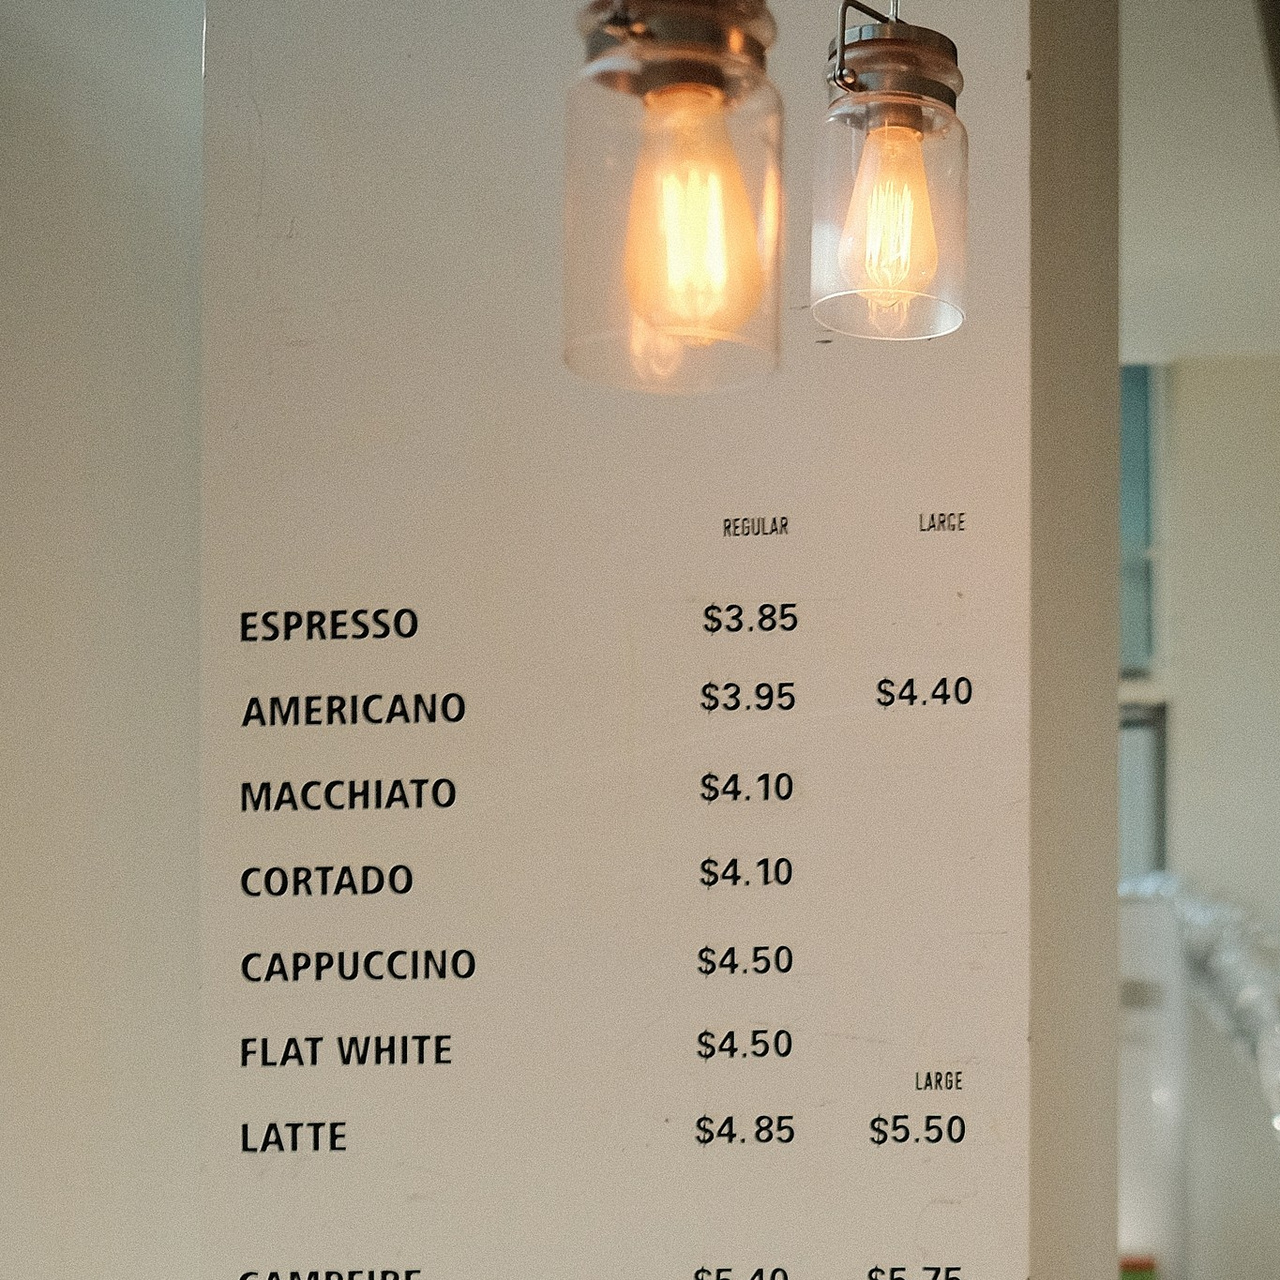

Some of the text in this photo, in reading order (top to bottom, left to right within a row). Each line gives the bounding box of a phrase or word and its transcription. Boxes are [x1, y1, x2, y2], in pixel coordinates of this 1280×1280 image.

[723, 512, 965, 537] REGULAR LARGE
[240, 603, 798, 642] ESPRESSO $3.85
[241, 676, 973, 727] AMERICANO $3.95 $4.40
[241, 772, 794, 812] MACCHIATO $4.10
[240, 857, 793, 897] CORTADO $4.10
[241, 945, 793, 983] CAPPUCCINO $4.50
[241, 1029, 793, 1067] FLAT WHITE $4.50
[915, 1070, 963, 1091] LARGE
[241, 1114, 966, 1153] LATTE $4.85 $5.50
